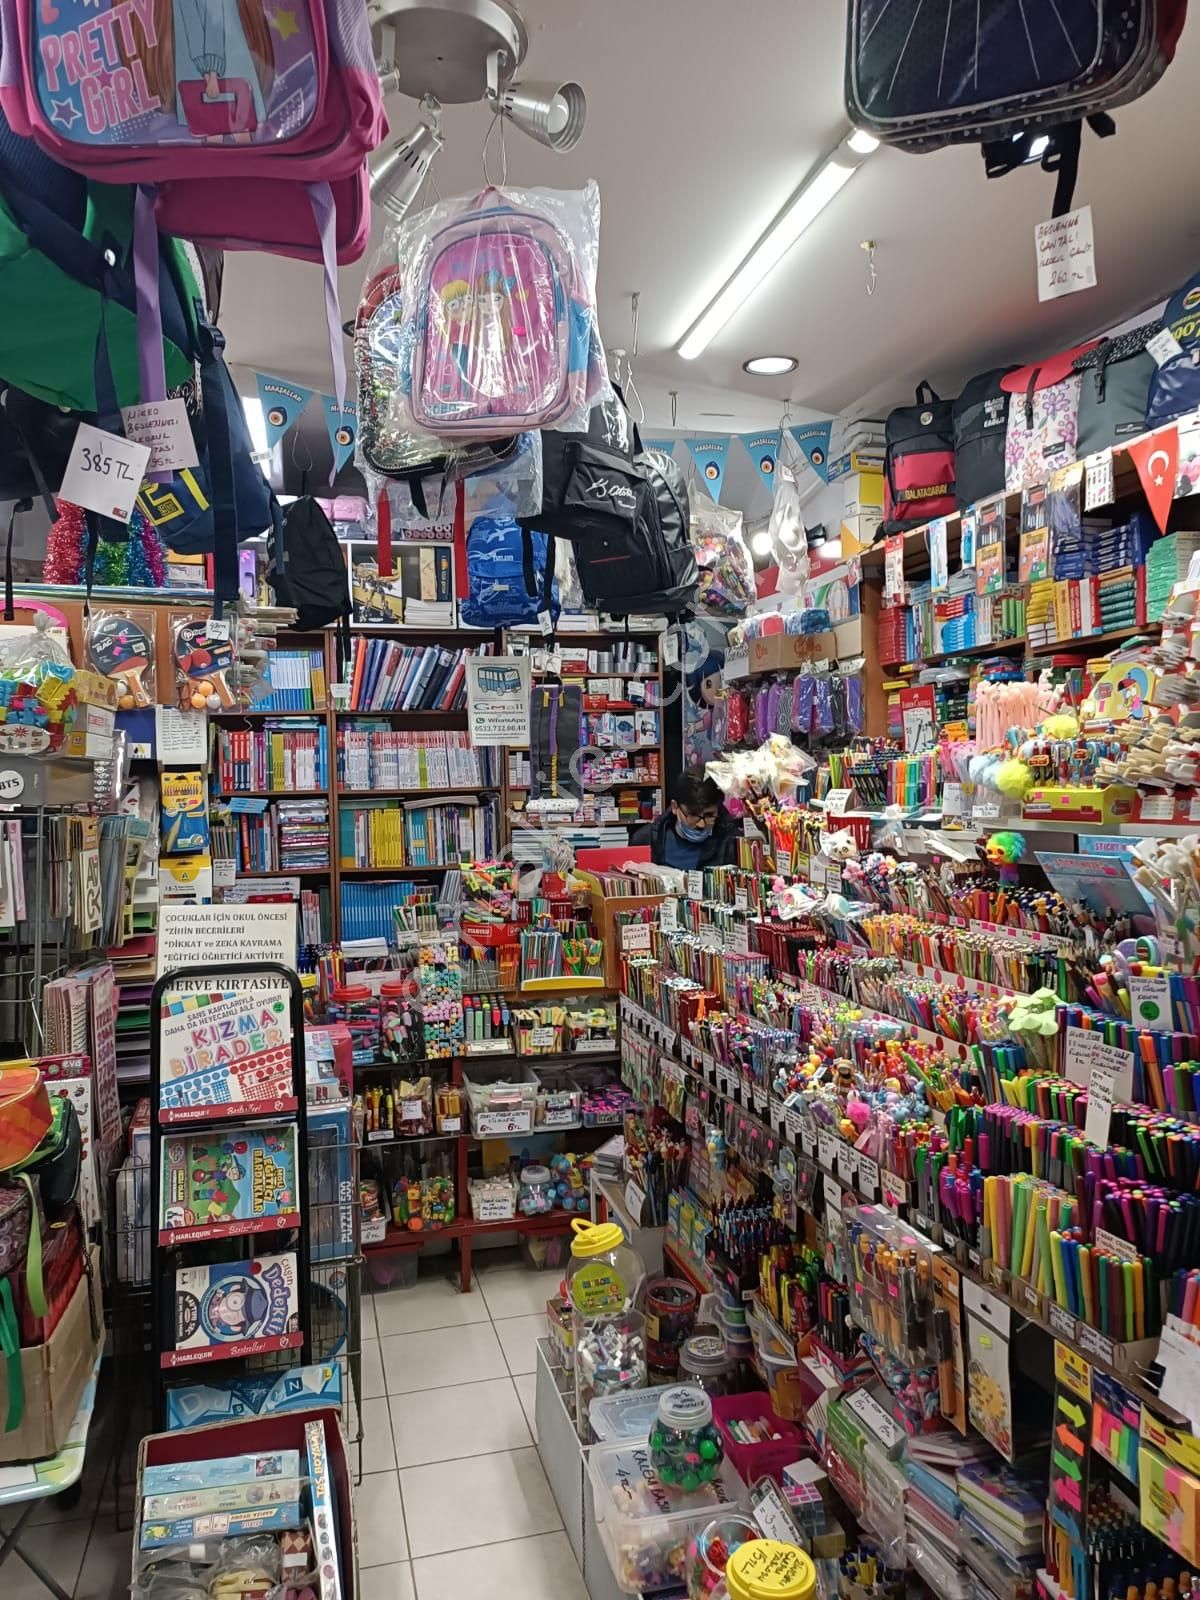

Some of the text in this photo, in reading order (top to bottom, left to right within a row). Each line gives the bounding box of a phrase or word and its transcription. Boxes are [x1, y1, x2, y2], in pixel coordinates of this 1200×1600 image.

[40, 0, 158, 92] PRETTY
[80, 447, 134, 481] 385 TL
[166, 913, 211, 922] ÇOCUKLAR
[213, 912, 230, 922] İÇİN
[258, 912, 287, 921] ÖNCESİ
[195, 926, 245, 935] BECERİLERİ
[202, 951, 242, 960] ÖĞRETİCİ
[244, 951, 284, 960] AKTİVİTE
[164, 978, 289, 991] MERVE KIRTASİYE
[165, 1026, 185, 1037] DAHA
[187, 1021, 197, 1029] DA
[200, 1010, 238, 1025] HEYECANLI
[192, 1009, 277, 1048] KIZMA
[169, 1028, 283, 1078] BİRADER
[252, 1149, 263, 1214] BARDAKLAR
[340, 1181, 352, 1202] 500
[175, 1230, 211, 1241] HARLEQUIN
[177, 1342, 266, 1362] HARLEQUIN Bestseller!
[632, 1450, 658, 1486] KALEM
